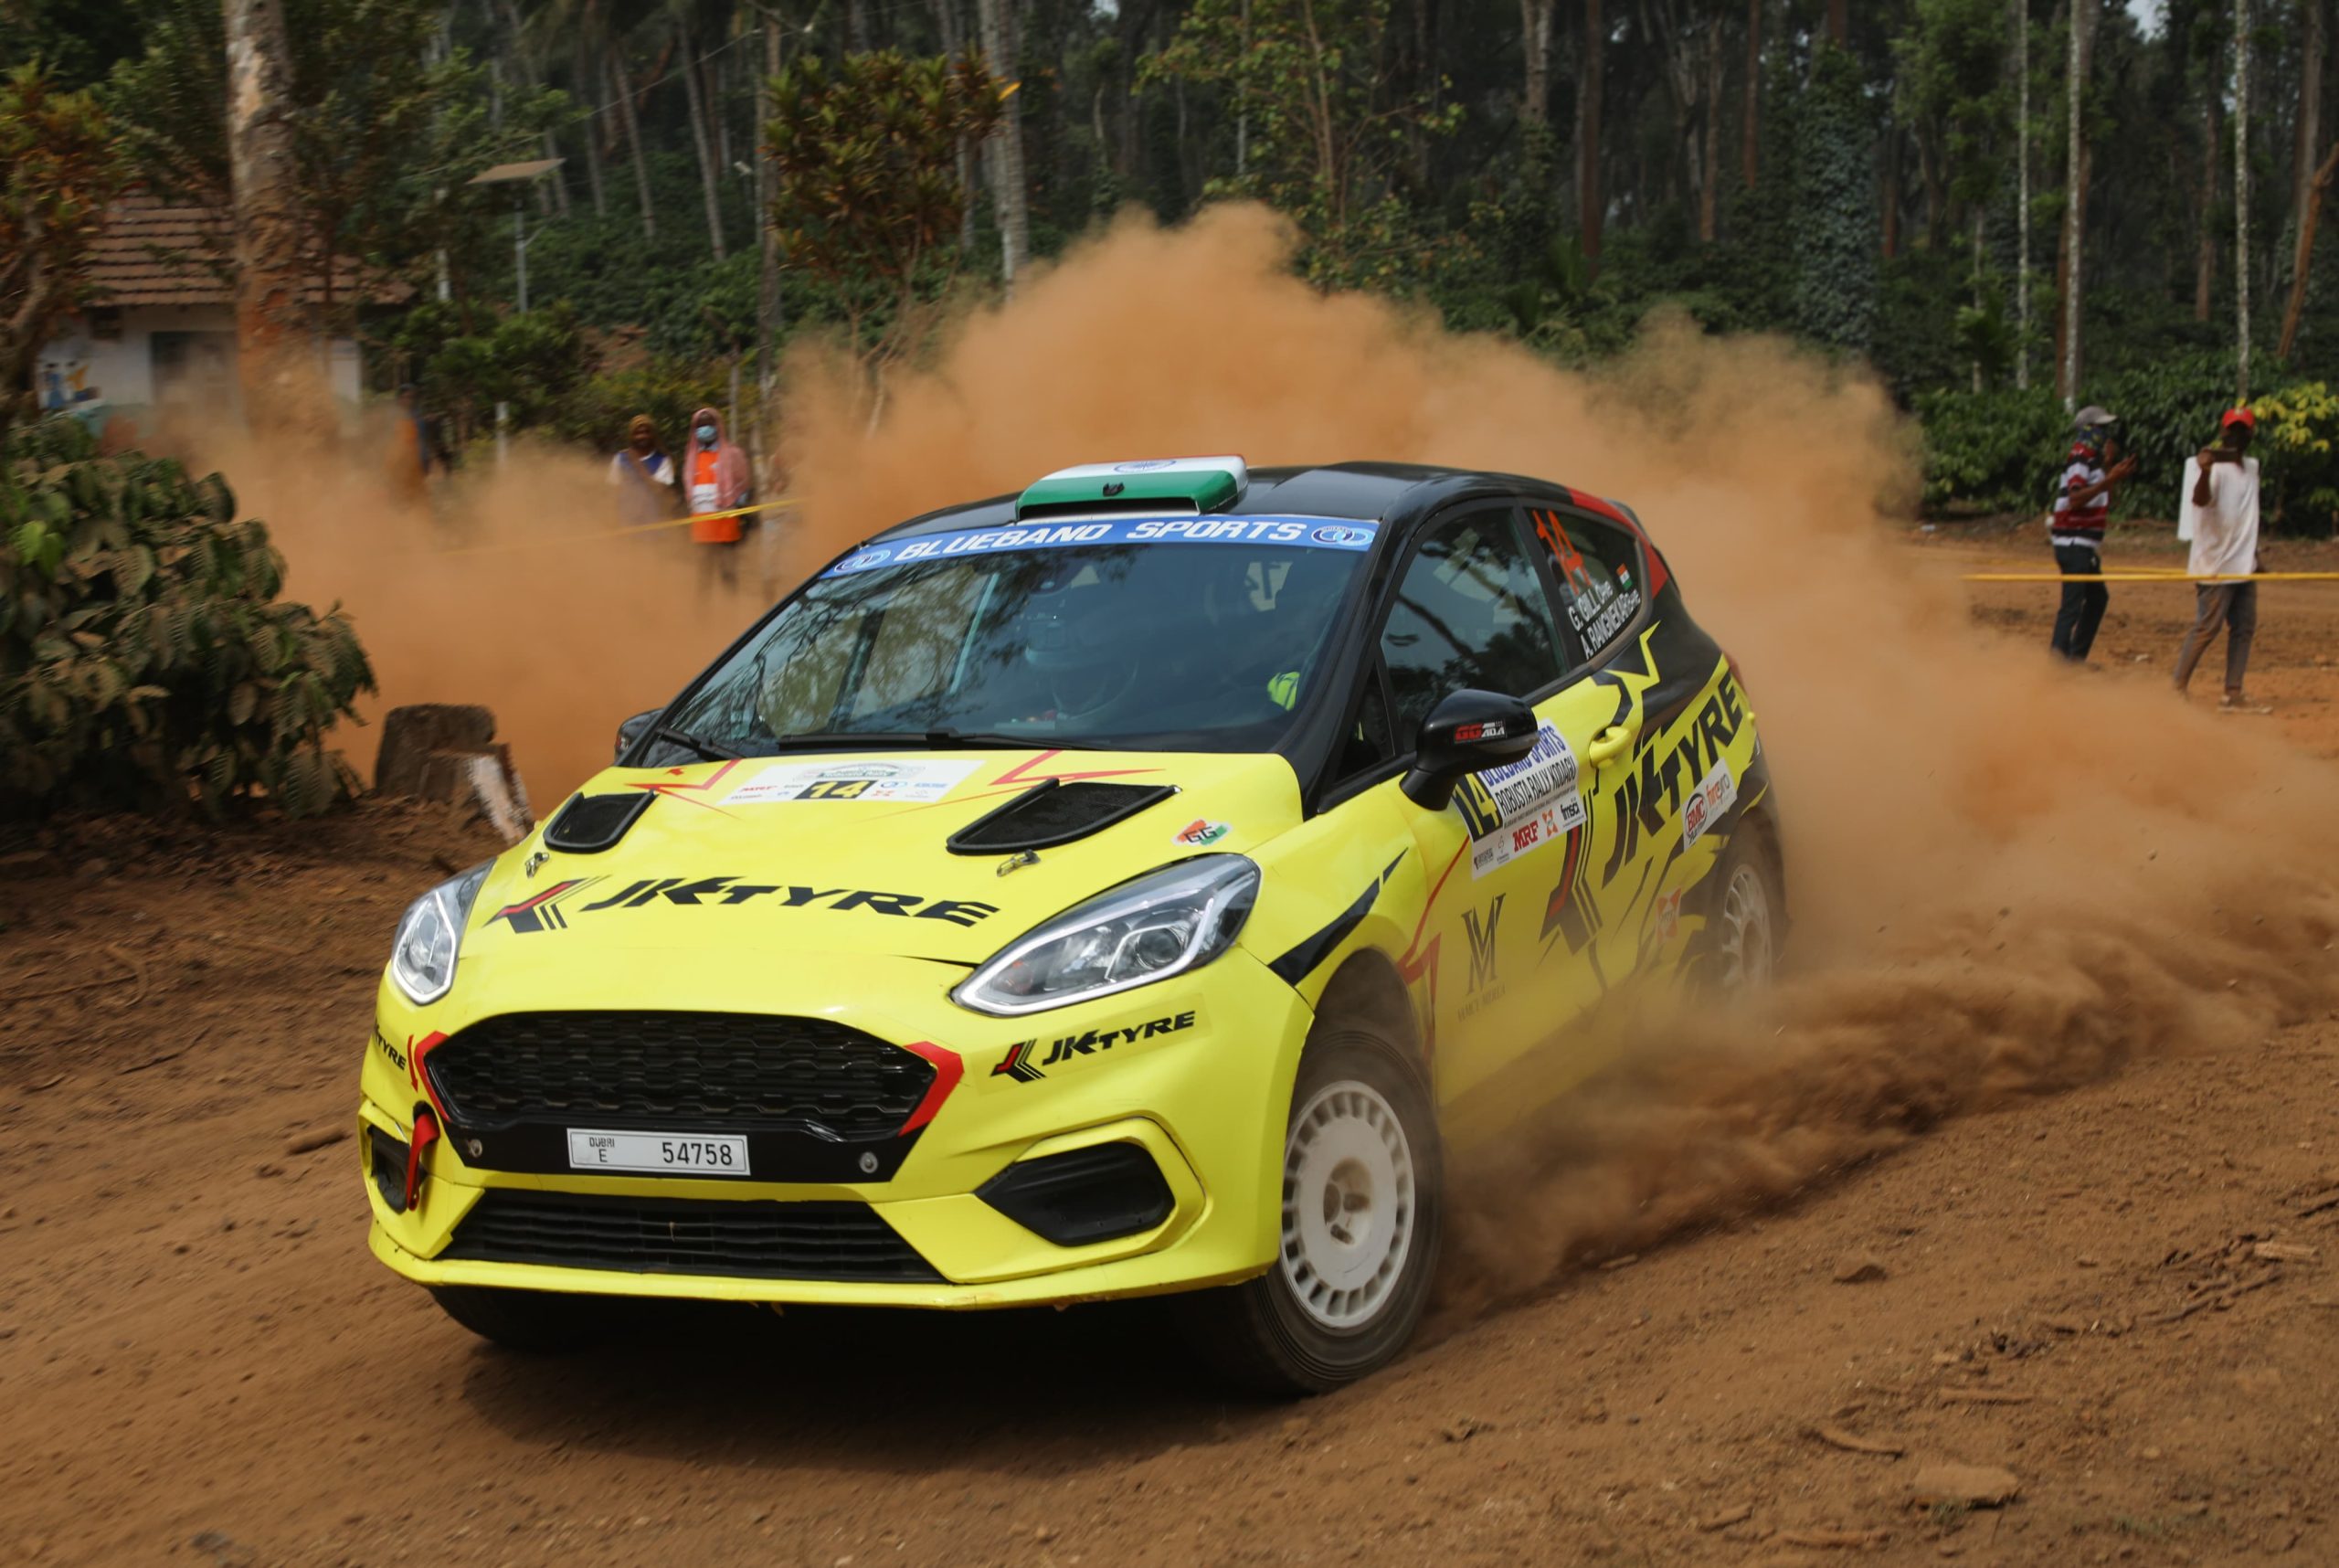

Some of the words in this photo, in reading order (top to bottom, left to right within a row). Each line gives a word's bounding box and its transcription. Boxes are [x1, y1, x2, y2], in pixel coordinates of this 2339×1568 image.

[894, 524, 1106, 561] BLUEBAND
[1126, 519, 1307, 542] SPORTS
[1532, 510, 1592, 596] 14
[1577, 588, 1602, 622] GILL
[810, 781, 866, 800] 14
[1452, 772, 1500, 836] 14
[1495, 779, 1534, 817] ROBUSTA
[1527, 768, 1551, 801] RALLY
[1512, 820, 1539, 853] MRF
[598, 1149, 609, 1163] E
[661, 1141, 734, 1167] 54758
